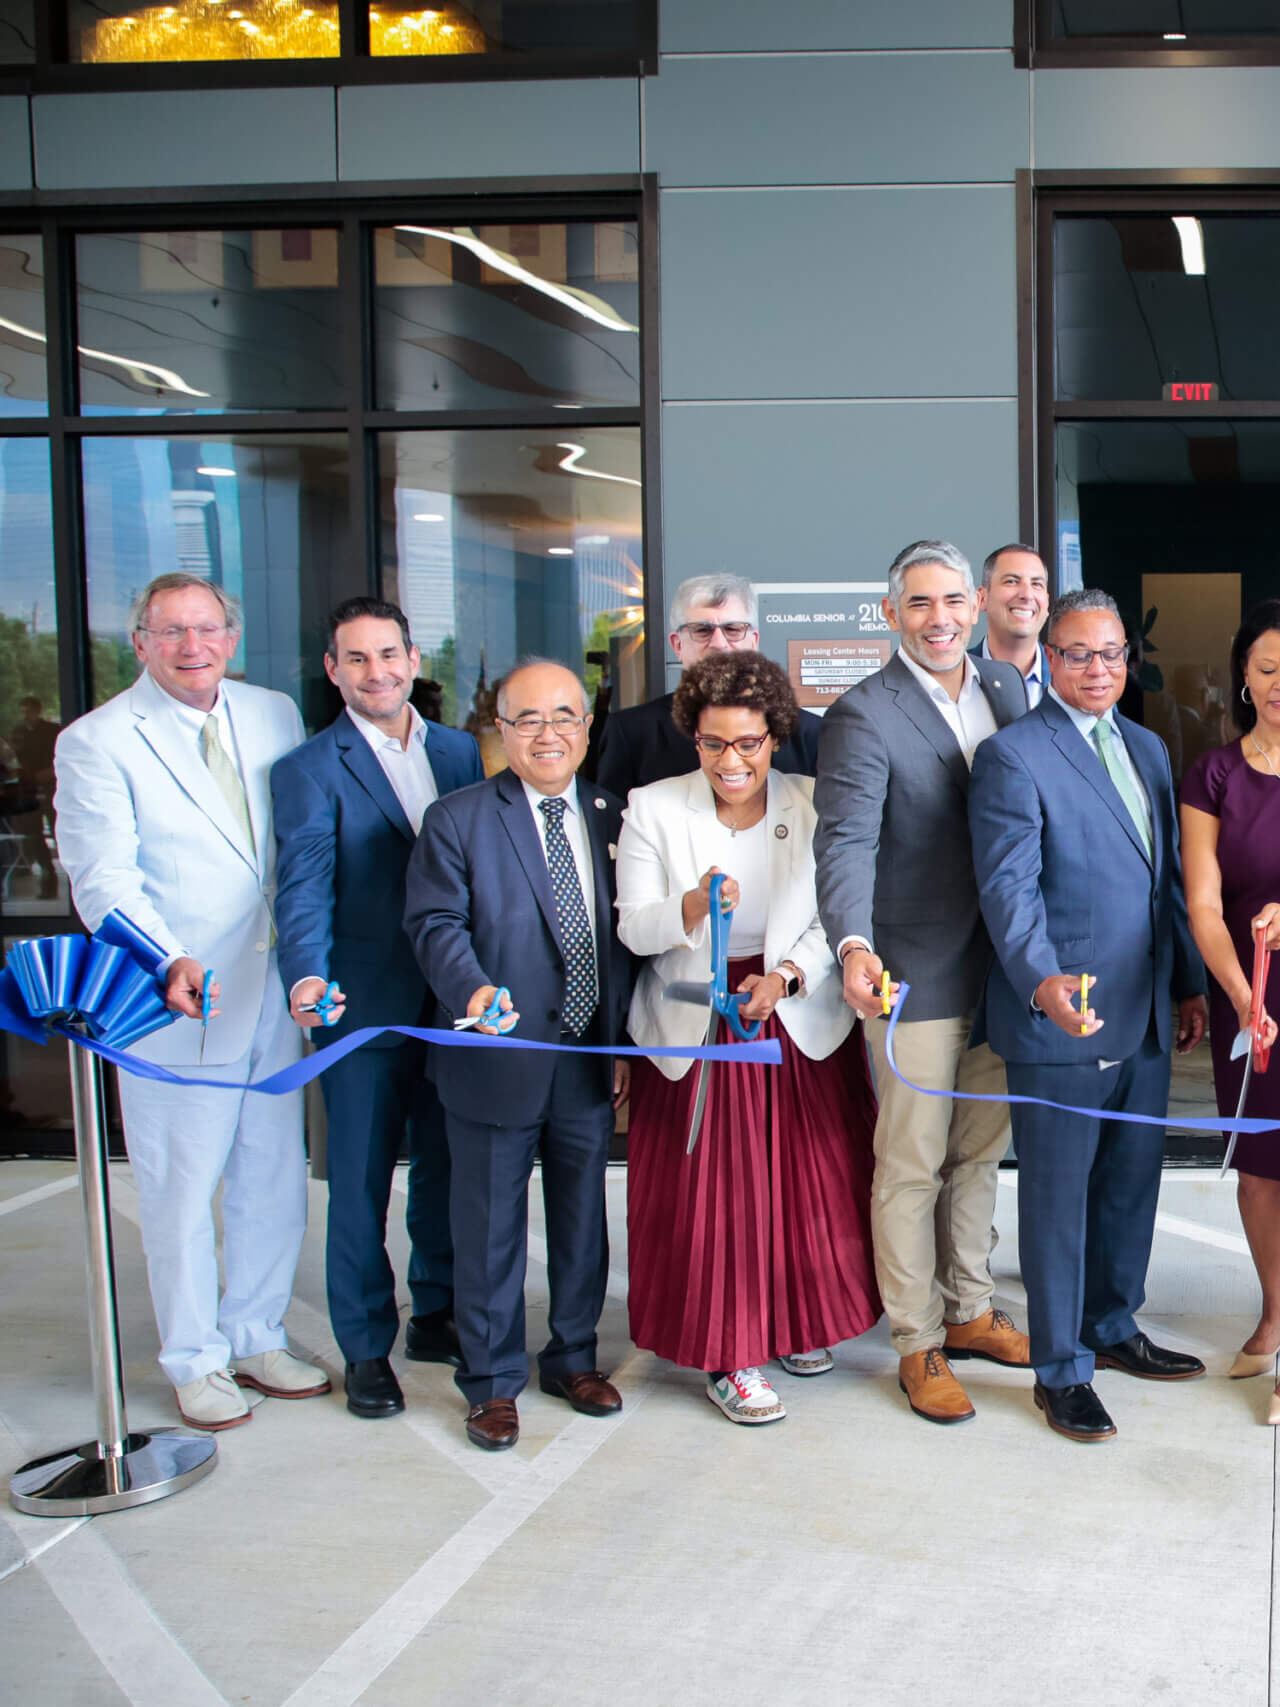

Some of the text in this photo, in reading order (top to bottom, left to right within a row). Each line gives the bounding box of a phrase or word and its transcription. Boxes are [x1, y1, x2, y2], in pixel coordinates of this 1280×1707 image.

[766, 614, 811, 623] COLUMBIA
[813, 613, 845, 623] SENIOR
[803, 648, 831, 657] Leasing
[833, 648, 856, 656] Center
